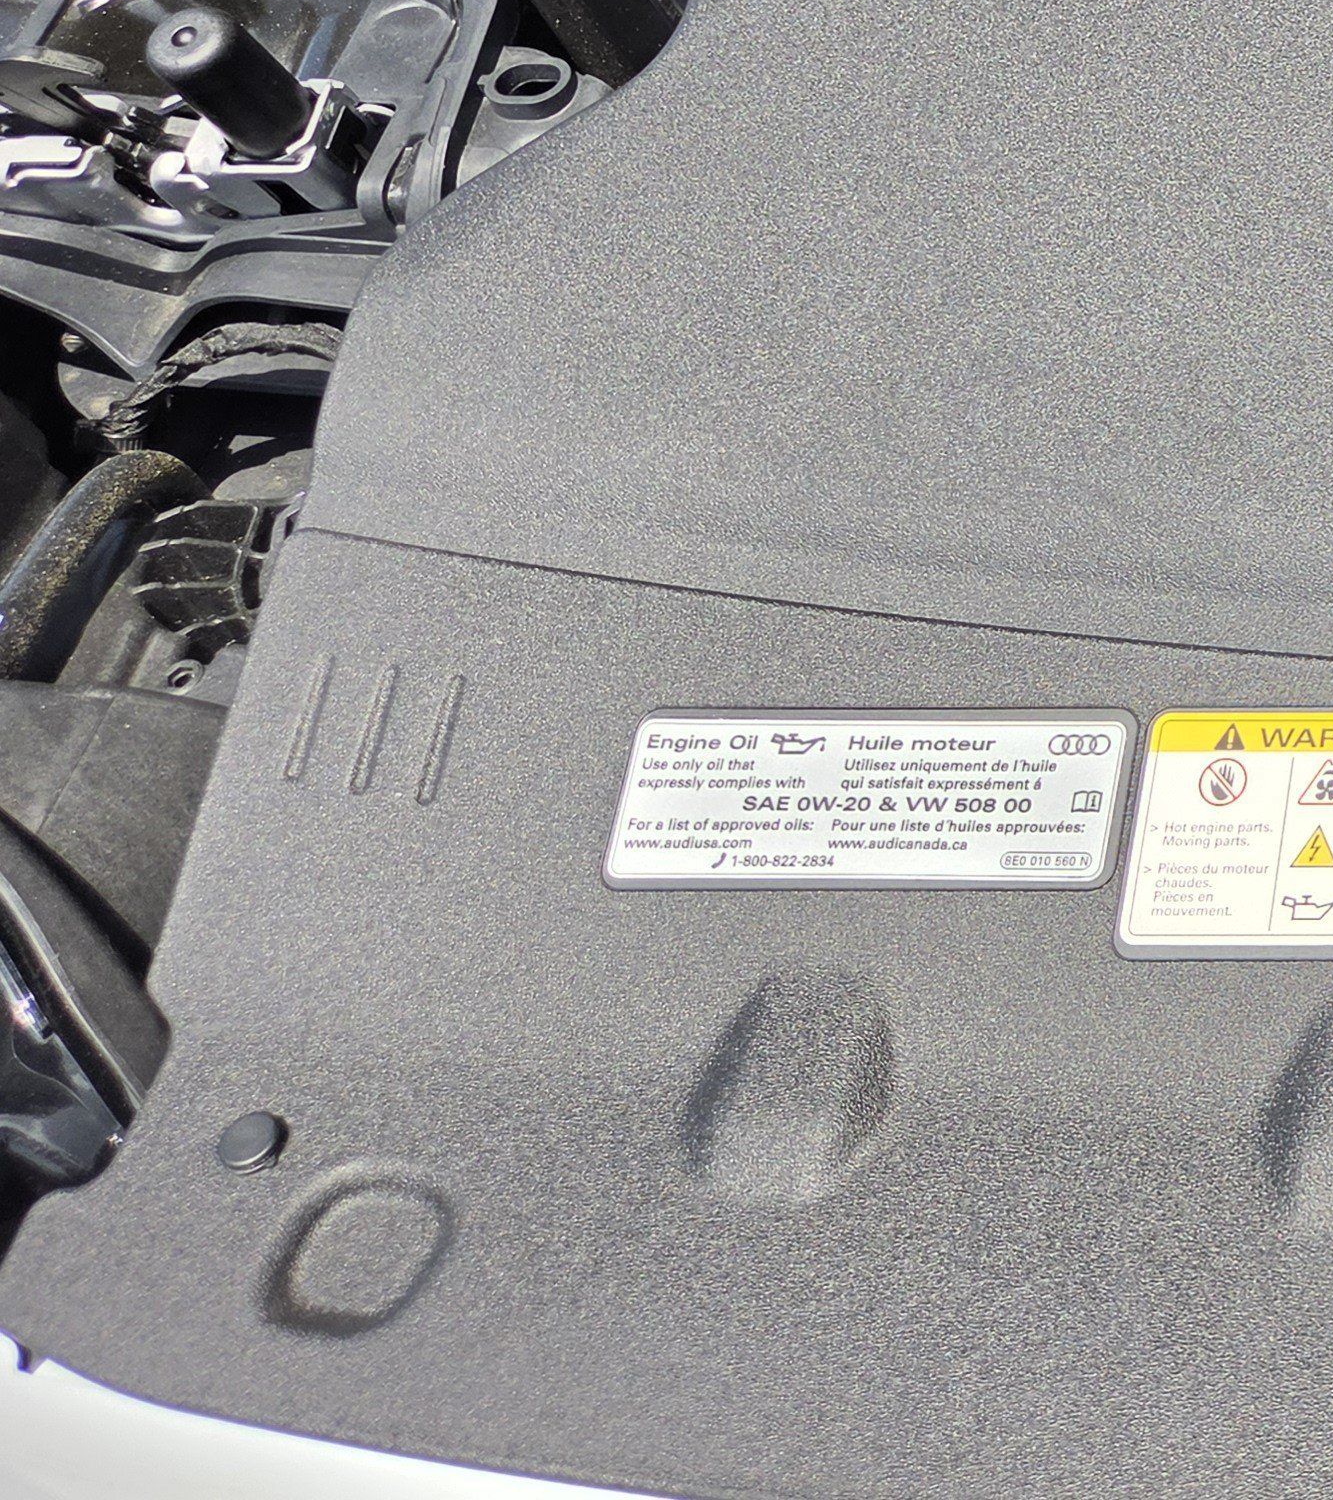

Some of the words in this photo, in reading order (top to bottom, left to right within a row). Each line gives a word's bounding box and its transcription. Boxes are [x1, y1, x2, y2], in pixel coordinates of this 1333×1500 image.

[647, 734, 721, 752] Engine
[730, 735, 758, 749] Oil
[849, 736, 903, 750] Huile
[911, 737, 996, 750] moteur
[642, 758, 668, 770] Use
[673, 758, 702, 772] only
[707, 758, 724, 770] oil
[728, 759, 755, 770] that
[844, 759, 895, 771] Utilisez
[900, 760, 987, 773] uniquement
[991, 760, 1008, 772] de
[638, 777, 703, 790] expressly
[708, 777, 771, 790] complies
[775, 777, 806, 788] with
[841, 778, 863, 791] qui
[868, 778, 923, 789] satisfait
[927, 778, 1028, 791] expressément
[742, 796, 790, 811] SAE
[797, 797, 871, 811] 0W-20
[878, 797, 897, 812] &
[906, 797, 948, 812] VW
[954, 798, 996, 812] 508
[1004, 798, 1032, 813] 00
[628, 818, 652, 831] For
[656, 821, 663, 831] a
[668, 818, 690, 831] list
[693, 818, 709, 831] of
[712, 818, 780, 833] approved
[784, 818, 814, 831] oils:
[831, 819, 865, 831] Pour
[870, 822, 895, 831] une
[901, 820, 930, 831] liste
[996, 821, 1085, 835] approuvées:
[1164, 822, 1186, 833] Hot
[1190, 822, 1234, 834] engine
[1238, 823, 1273, 834] parts.
[624, 837, 752, 849] www.audiusa.com
[828, 839, 968, 850] www.audicanada.ca
[1162, 835, 1210, 848] Moving
[1214, 837, 1250, 848] parts.
[732, 855, 834, 866] 1-800-822-2834
[1005, 856, 1026, 866] 8E0
[1030, 856, 1050, 866] 010
[1055, 856, 1076, 866] 560
[1080, 856, 1089, 866] N
[1158, 862, 1198, 874] Pièces
[1202, 864, 1218, 874] du
[1222, 864, 1270, 874] moteur
[1155, 878, 1212, 888] chaudes.
[1198, 893, 1214, 902] en
